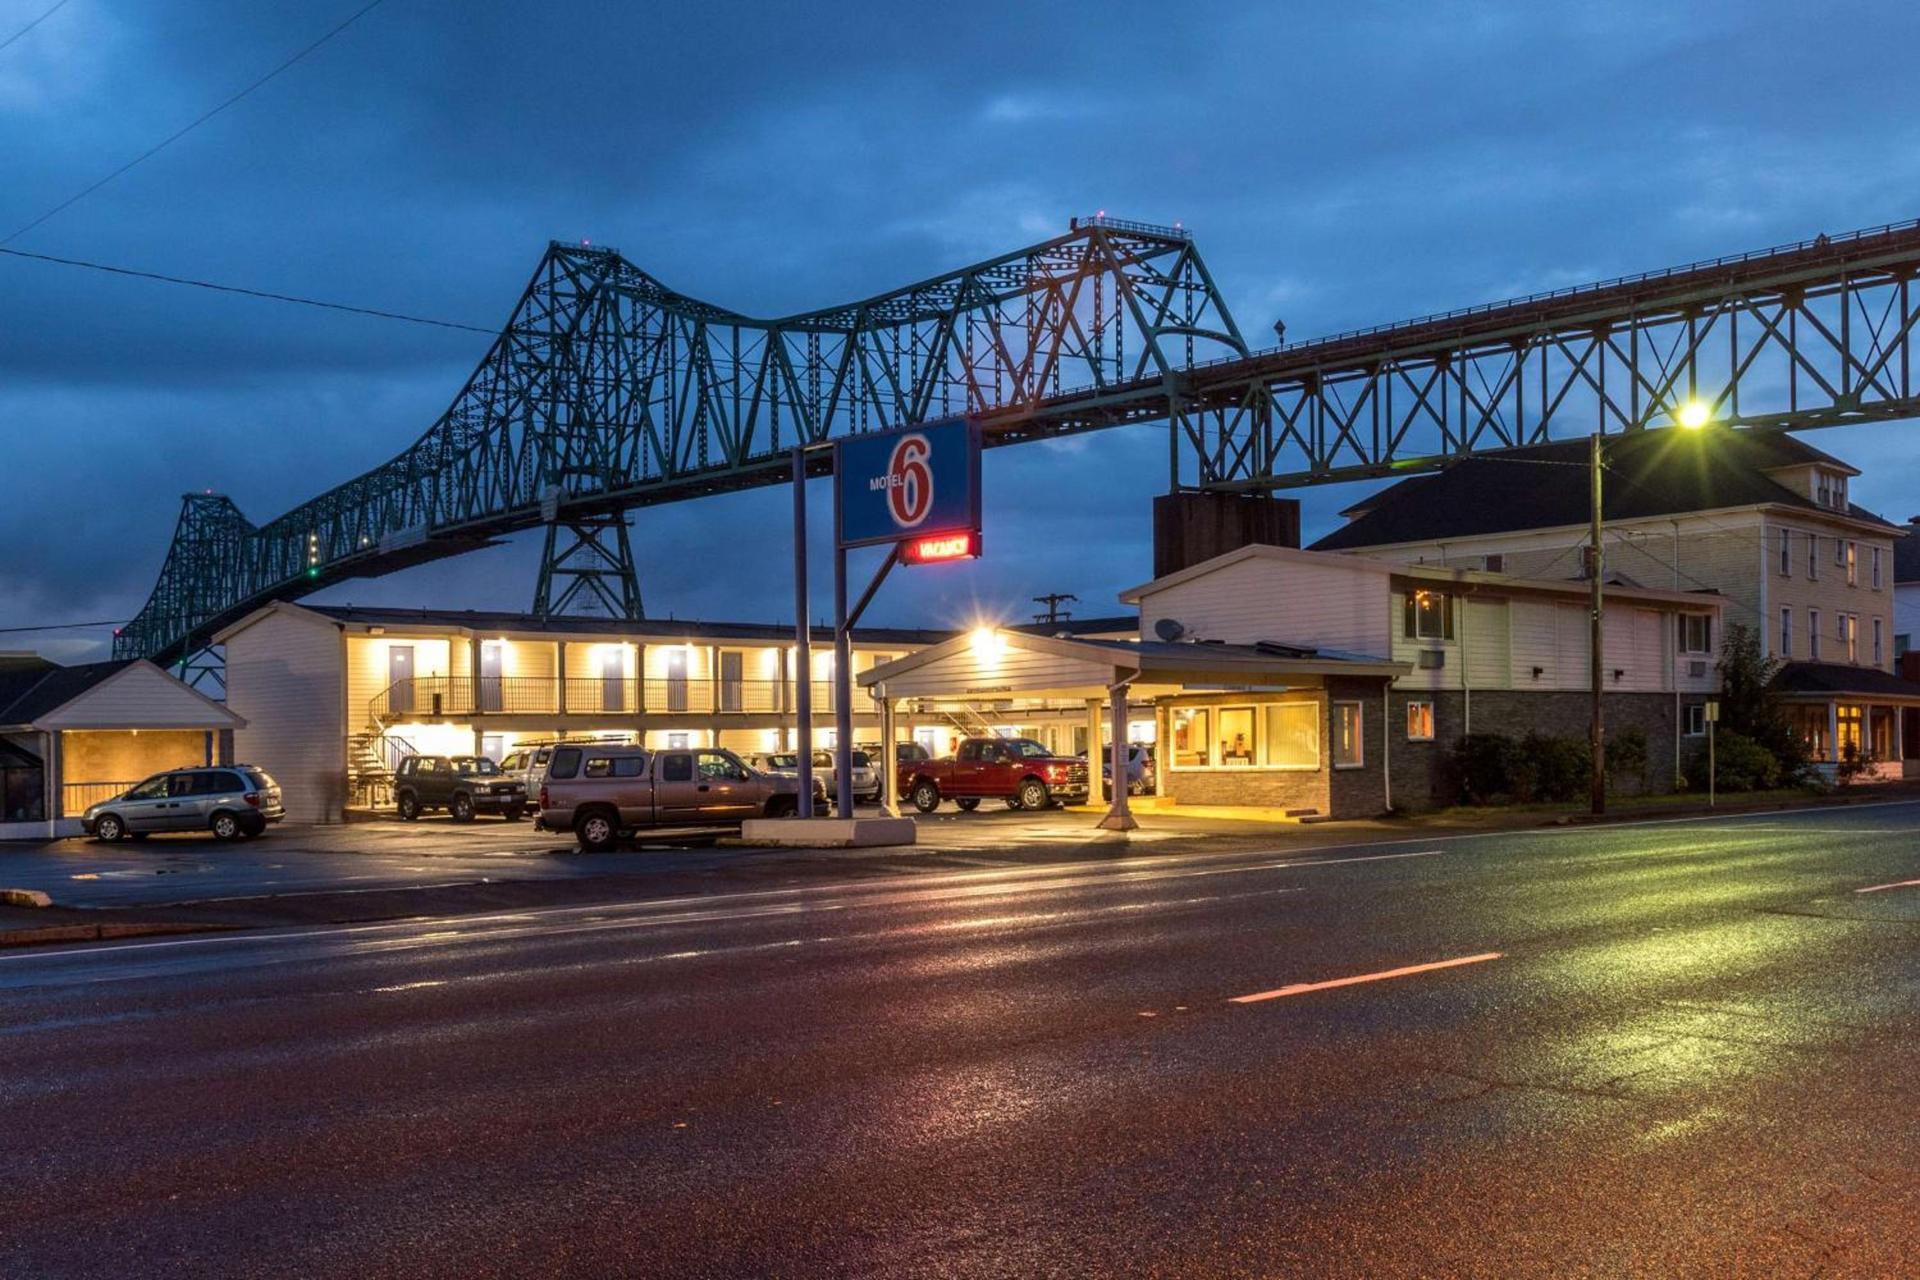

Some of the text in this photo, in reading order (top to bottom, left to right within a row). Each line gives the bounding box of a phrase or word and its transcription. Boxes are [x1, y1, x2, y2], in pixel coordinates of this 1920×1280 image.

[869, 434, 934, 527] MOTEL 6
[919, 537, 968, 557] VACANCY
